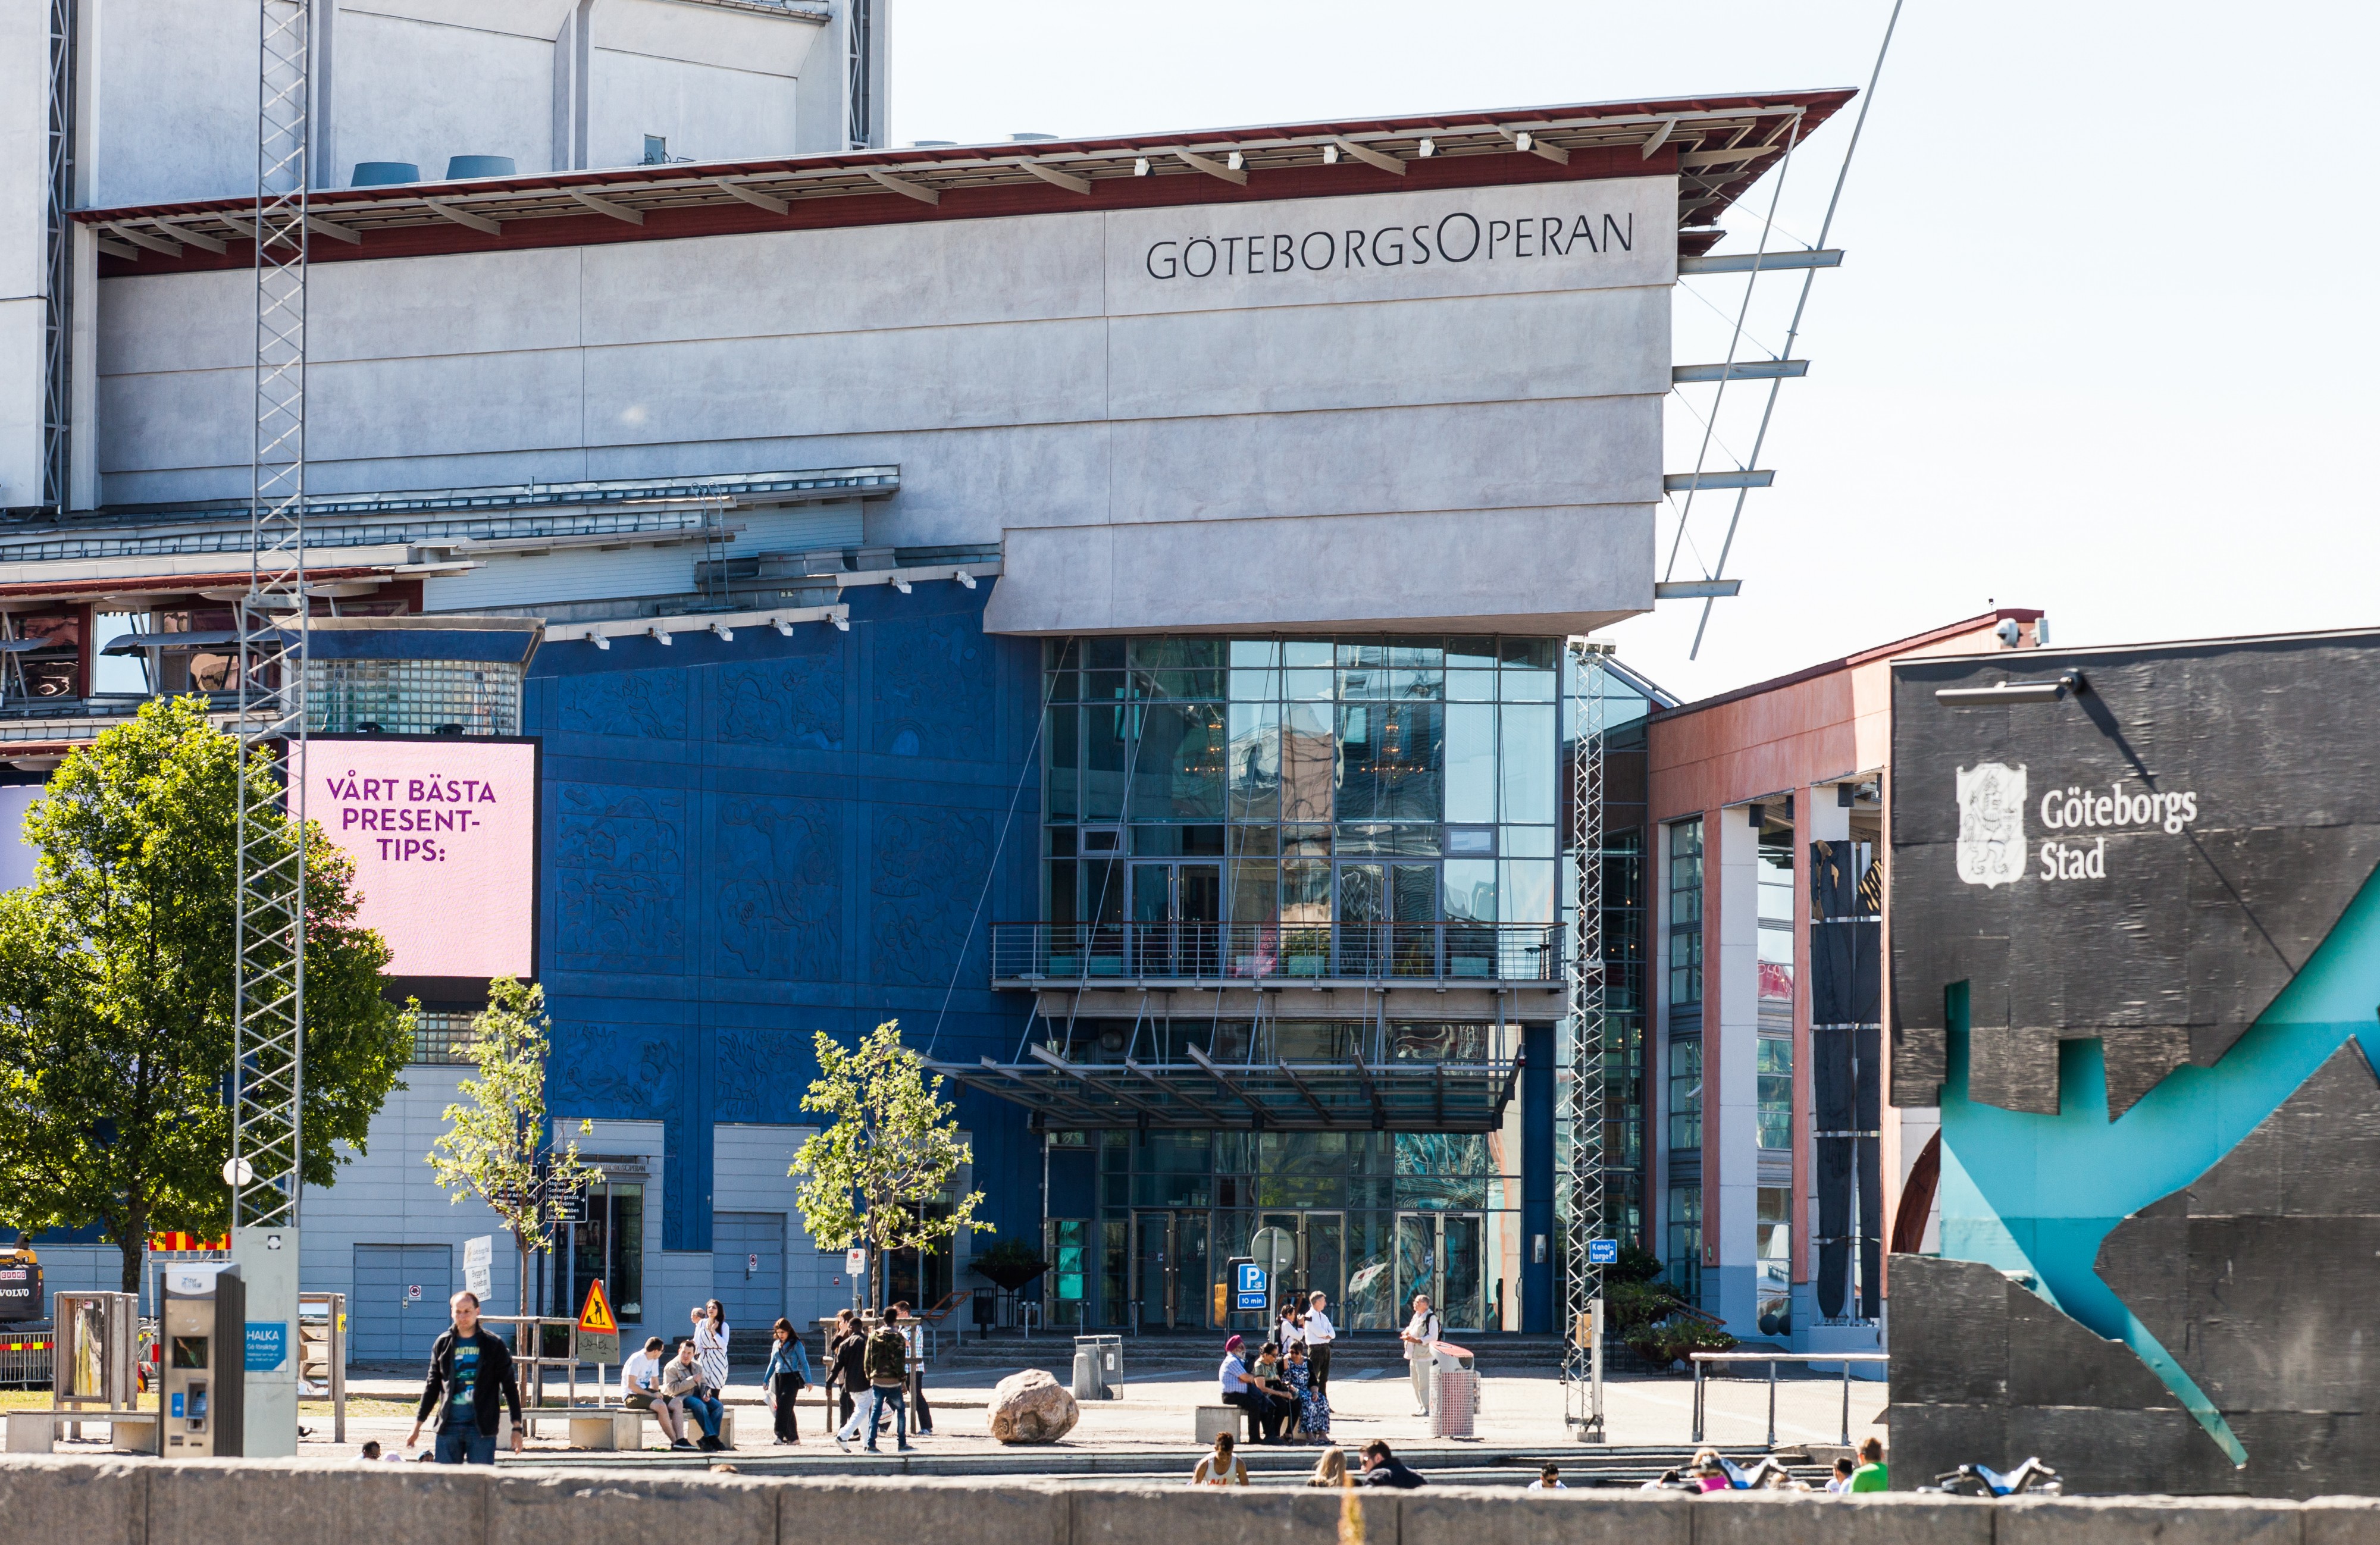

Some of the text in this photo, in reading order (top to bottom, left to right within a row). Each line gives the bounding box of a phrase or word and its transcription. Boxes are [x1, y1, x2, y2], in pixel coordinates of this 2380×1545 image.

[1147, 212, 1632, 280] GÖTEBORGSOPERAN
[326, 770, 496, 803] VÅRT BÄSTA
[342, 808, 480, 832] PRESENT-
[2041, 783, 2197, 835] Göteborgs
[377, 838, 445, 861] TIPS:
[2040, 836, 2106, 881] Stad
[1247, 1267, 1260, 1289] P
[0, 1289, 29, 1297] VOLVO
[246, 1330, 280, 1341] HALKA
